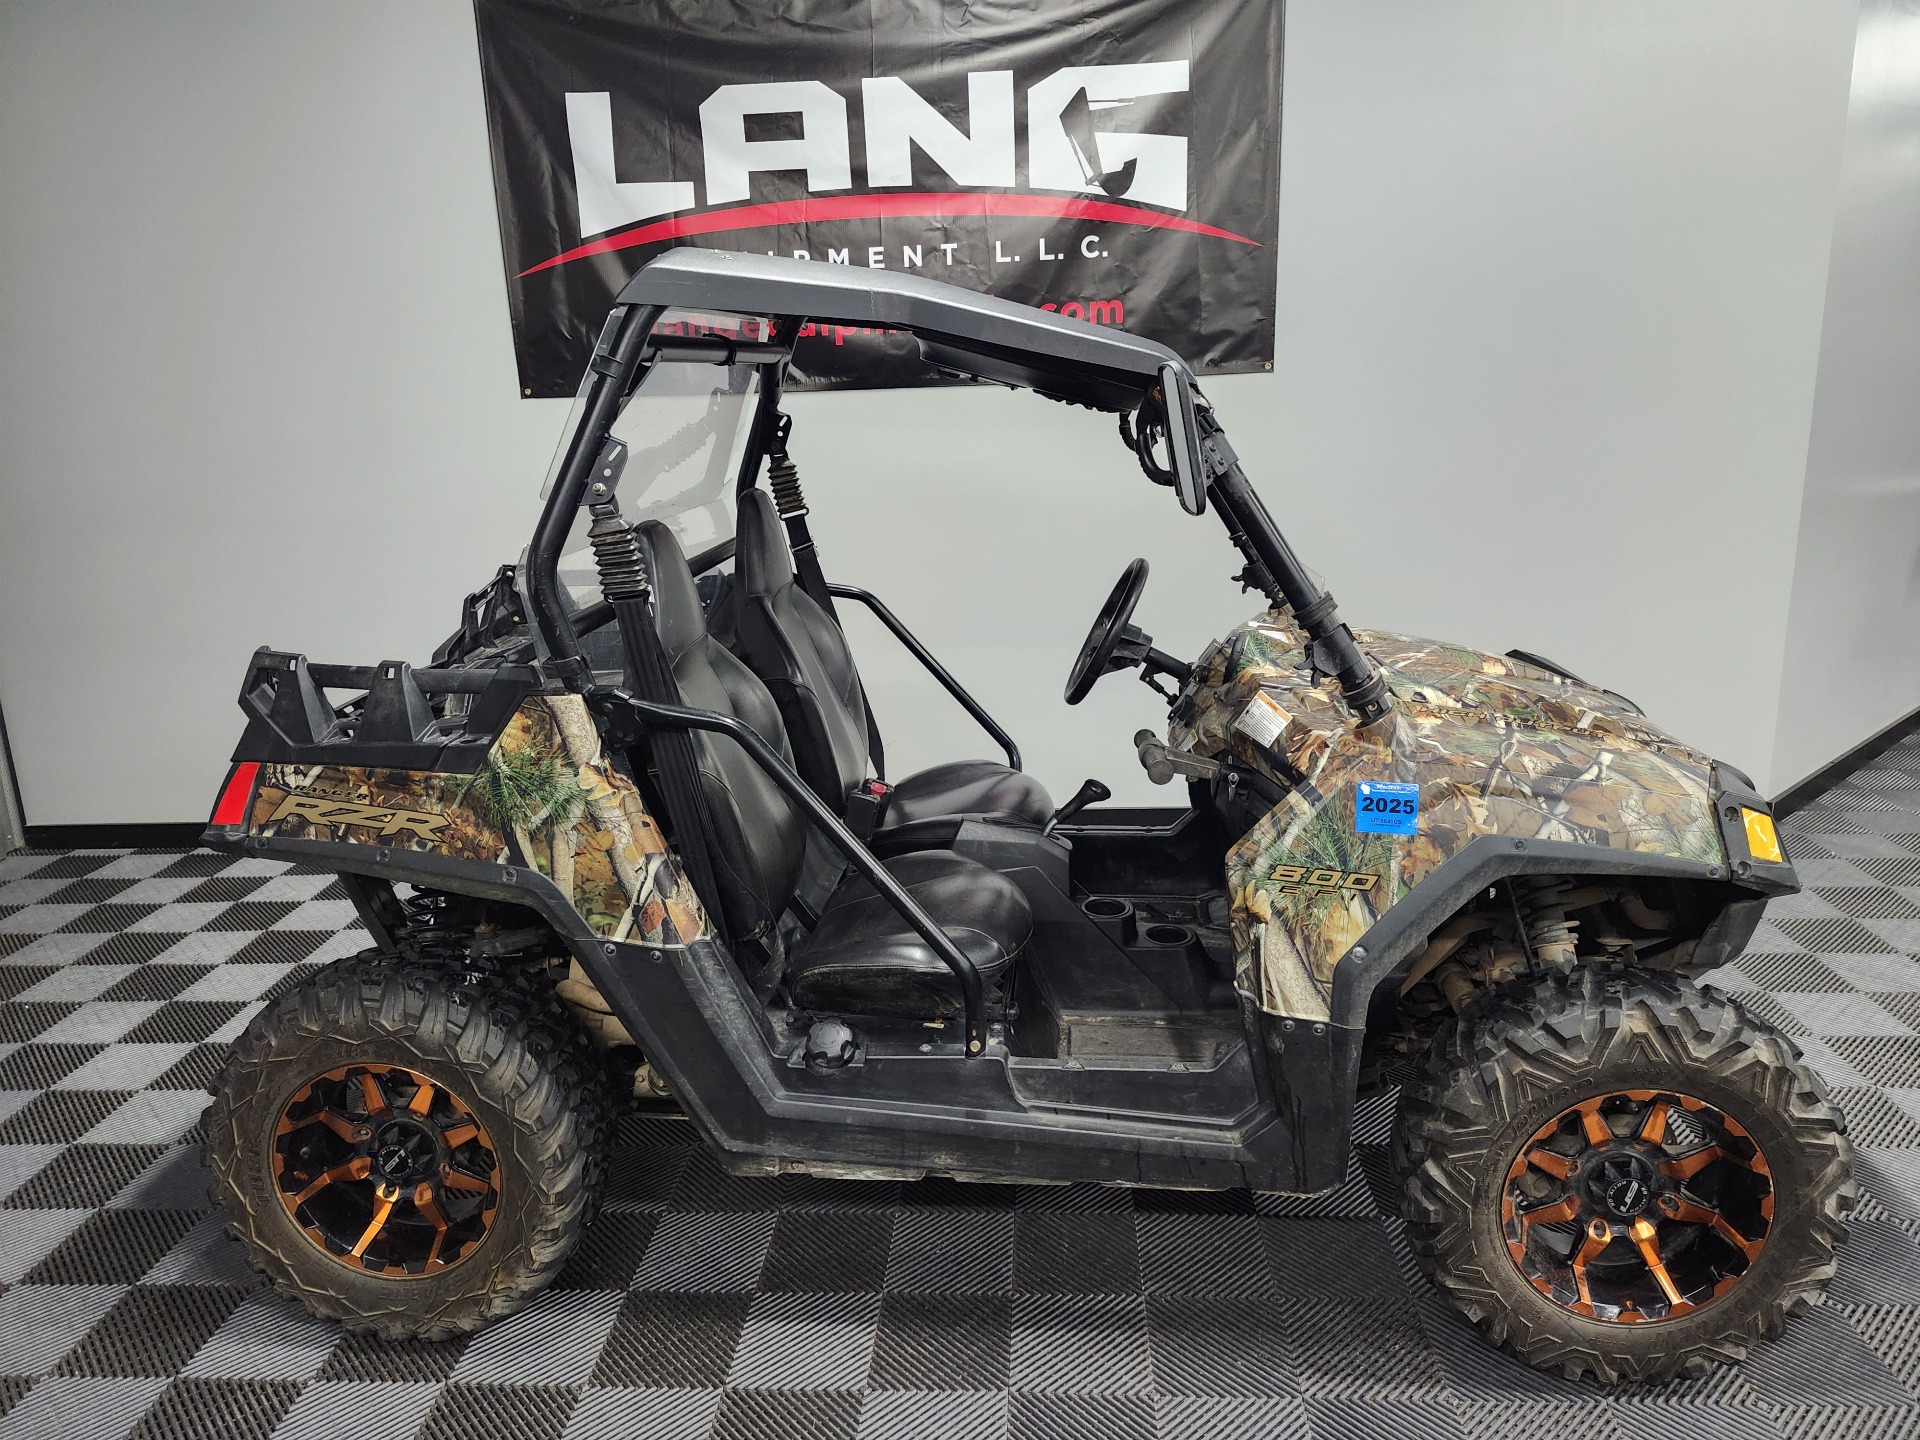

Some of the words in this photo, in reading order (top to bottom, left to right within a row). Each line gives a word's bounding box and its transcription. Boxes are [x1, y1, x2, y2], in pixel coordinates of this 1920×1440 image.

[565, 60, 1190, 240] LANG
[291, 784, 370, 800] RANGER
[1361, 796, 1415, 815] 2025
[266, 793, 452, 845] RZR
[1268, 863, 1381, 892] 800
[1278, 884, 1358, 902] EFI
